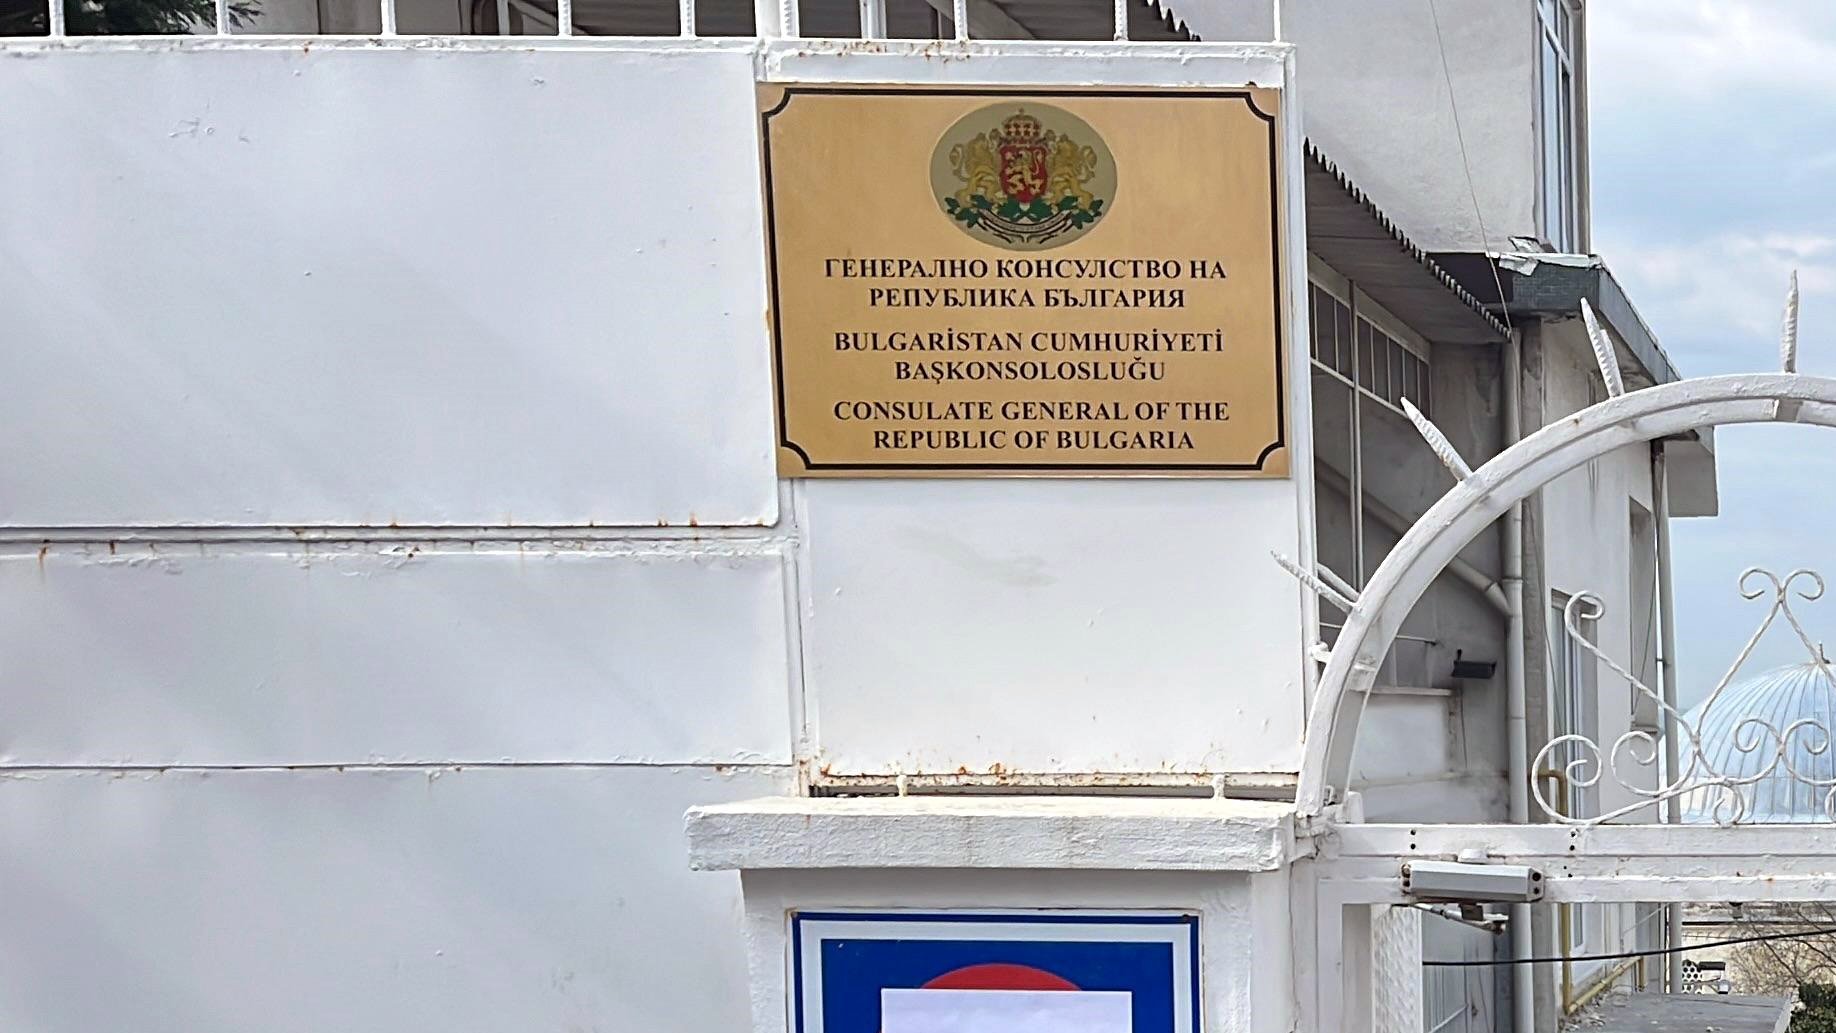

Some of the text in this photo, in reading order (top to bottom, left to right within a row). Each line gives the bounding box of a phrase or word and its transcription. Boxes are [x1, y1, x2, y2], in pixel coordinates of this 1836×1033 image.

[825, 258, 1227, 280] ГЕНЕРАЛНО КОНСУЛСТВО НА
[869, 287, 1185, 308] РЕПУБЛИКА БЪЛГАРИЯ
[834, 327, 1223, 352] BULGARİSTAN CUMHURİYETİ
[894, 355, 1165, 385] BAŞKONSOLOSLUĞU
[834, 401, 1230, 421] CONSULATE GENERAL OF THE
[873, 429, 1194, 450] REPUBLIC OF BULGARIA
